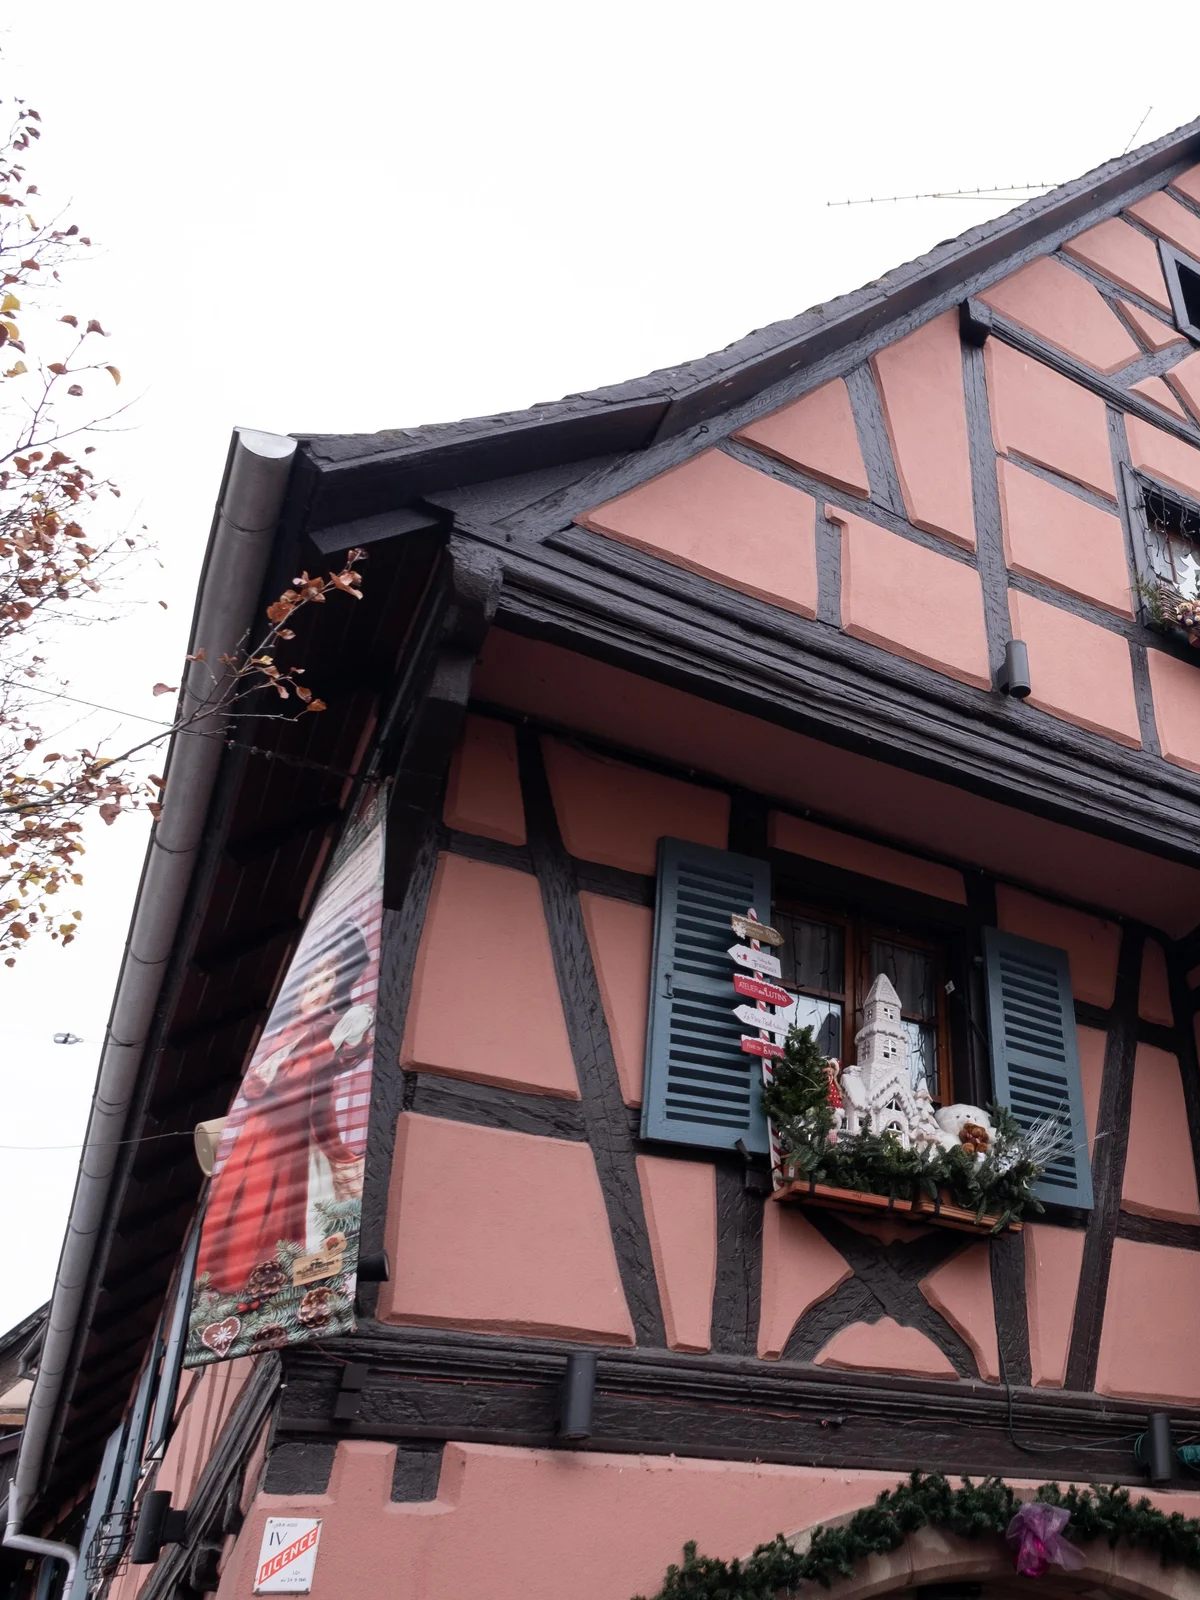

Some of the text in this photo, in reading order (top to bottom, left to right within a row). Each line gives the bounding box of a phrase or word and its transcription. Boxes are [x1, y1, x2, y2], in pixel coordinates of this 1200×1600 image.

[739, 981, 759, 993] ATELIER
[765, 988, 787, 1002] LUTINS
[269, 1531, 288, 1546] IV
[261, 1530, 316, 1581] LICENCE
